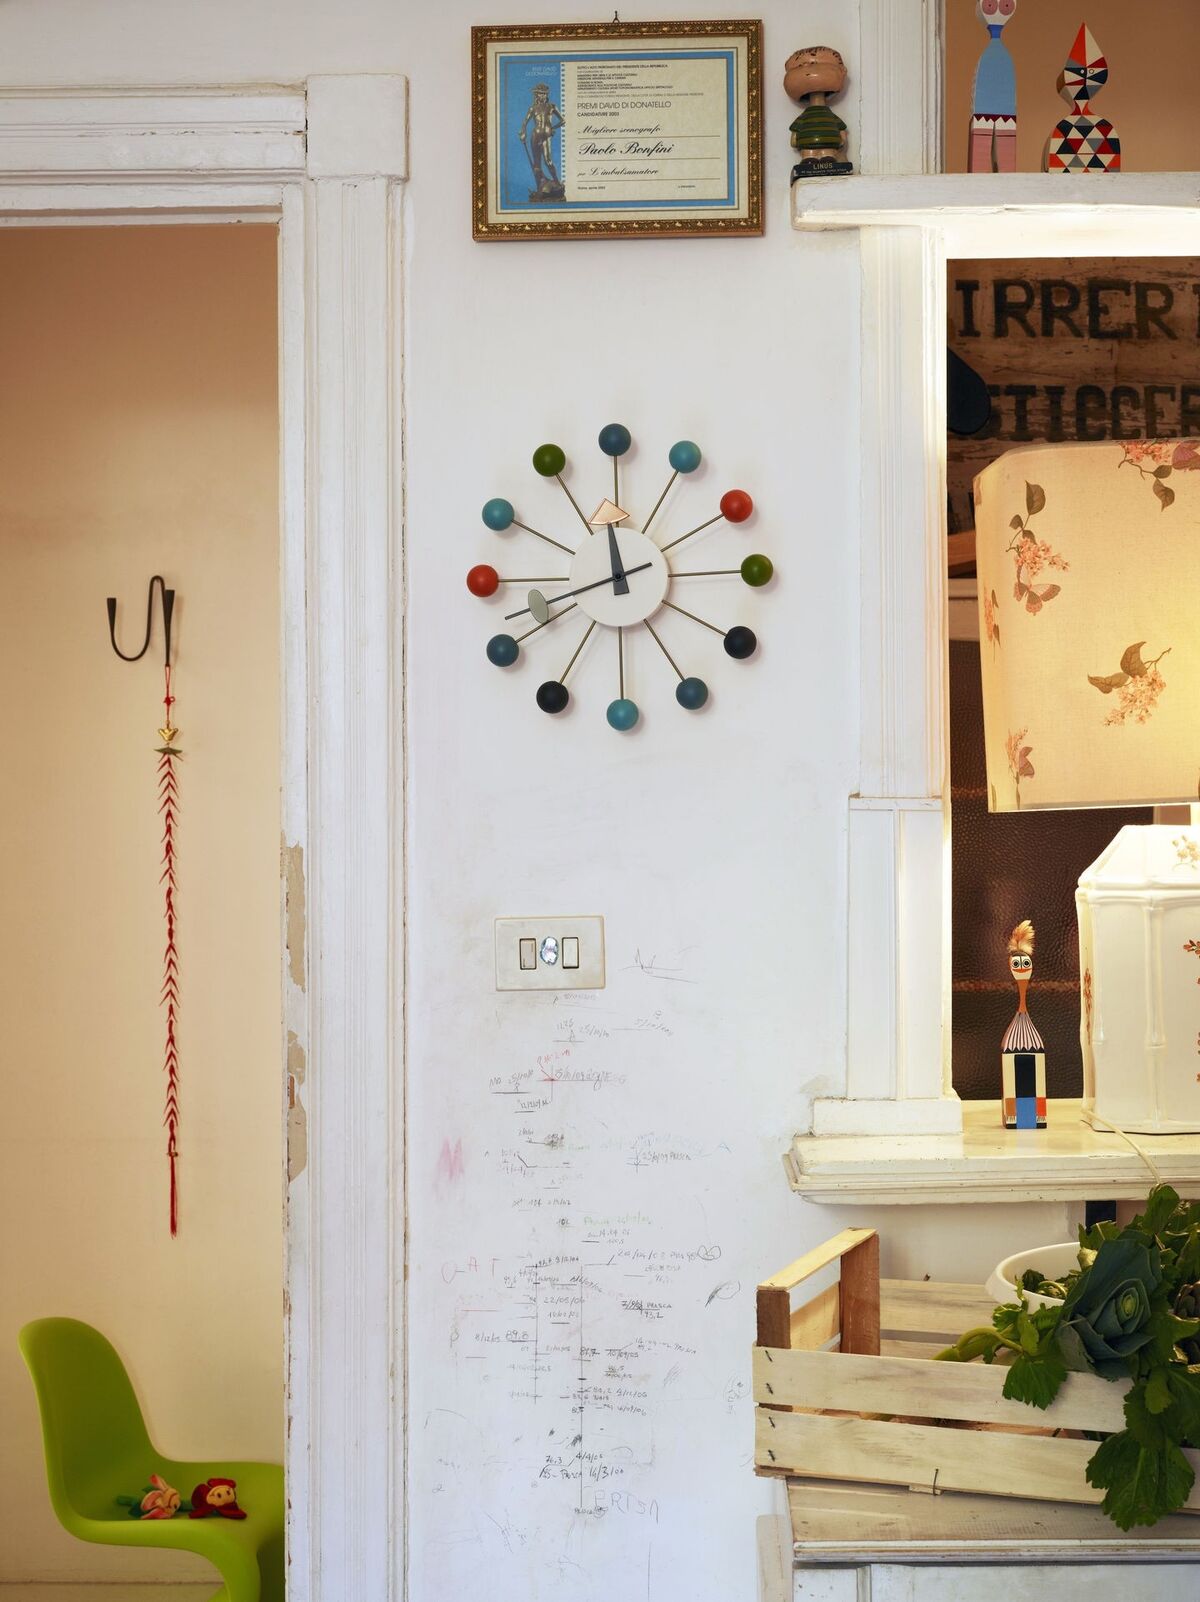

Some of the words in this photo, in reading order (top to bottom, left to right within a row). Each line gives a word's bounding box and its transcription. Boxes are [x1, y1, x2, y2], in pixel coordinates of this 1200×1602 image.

[577, 101, 598, 110] PREMI
[599, 101, 620, 109] DAVID
[622, 101, 630, 109] DI
[630, 100, 672, 108] DONATELLO
[578, 125, 618, 135] Migliore
[619, 124, 661, 135] scenografo
[579, 142, 617, 156] Paolo
[620, 140, 674, 157] Bonfini
